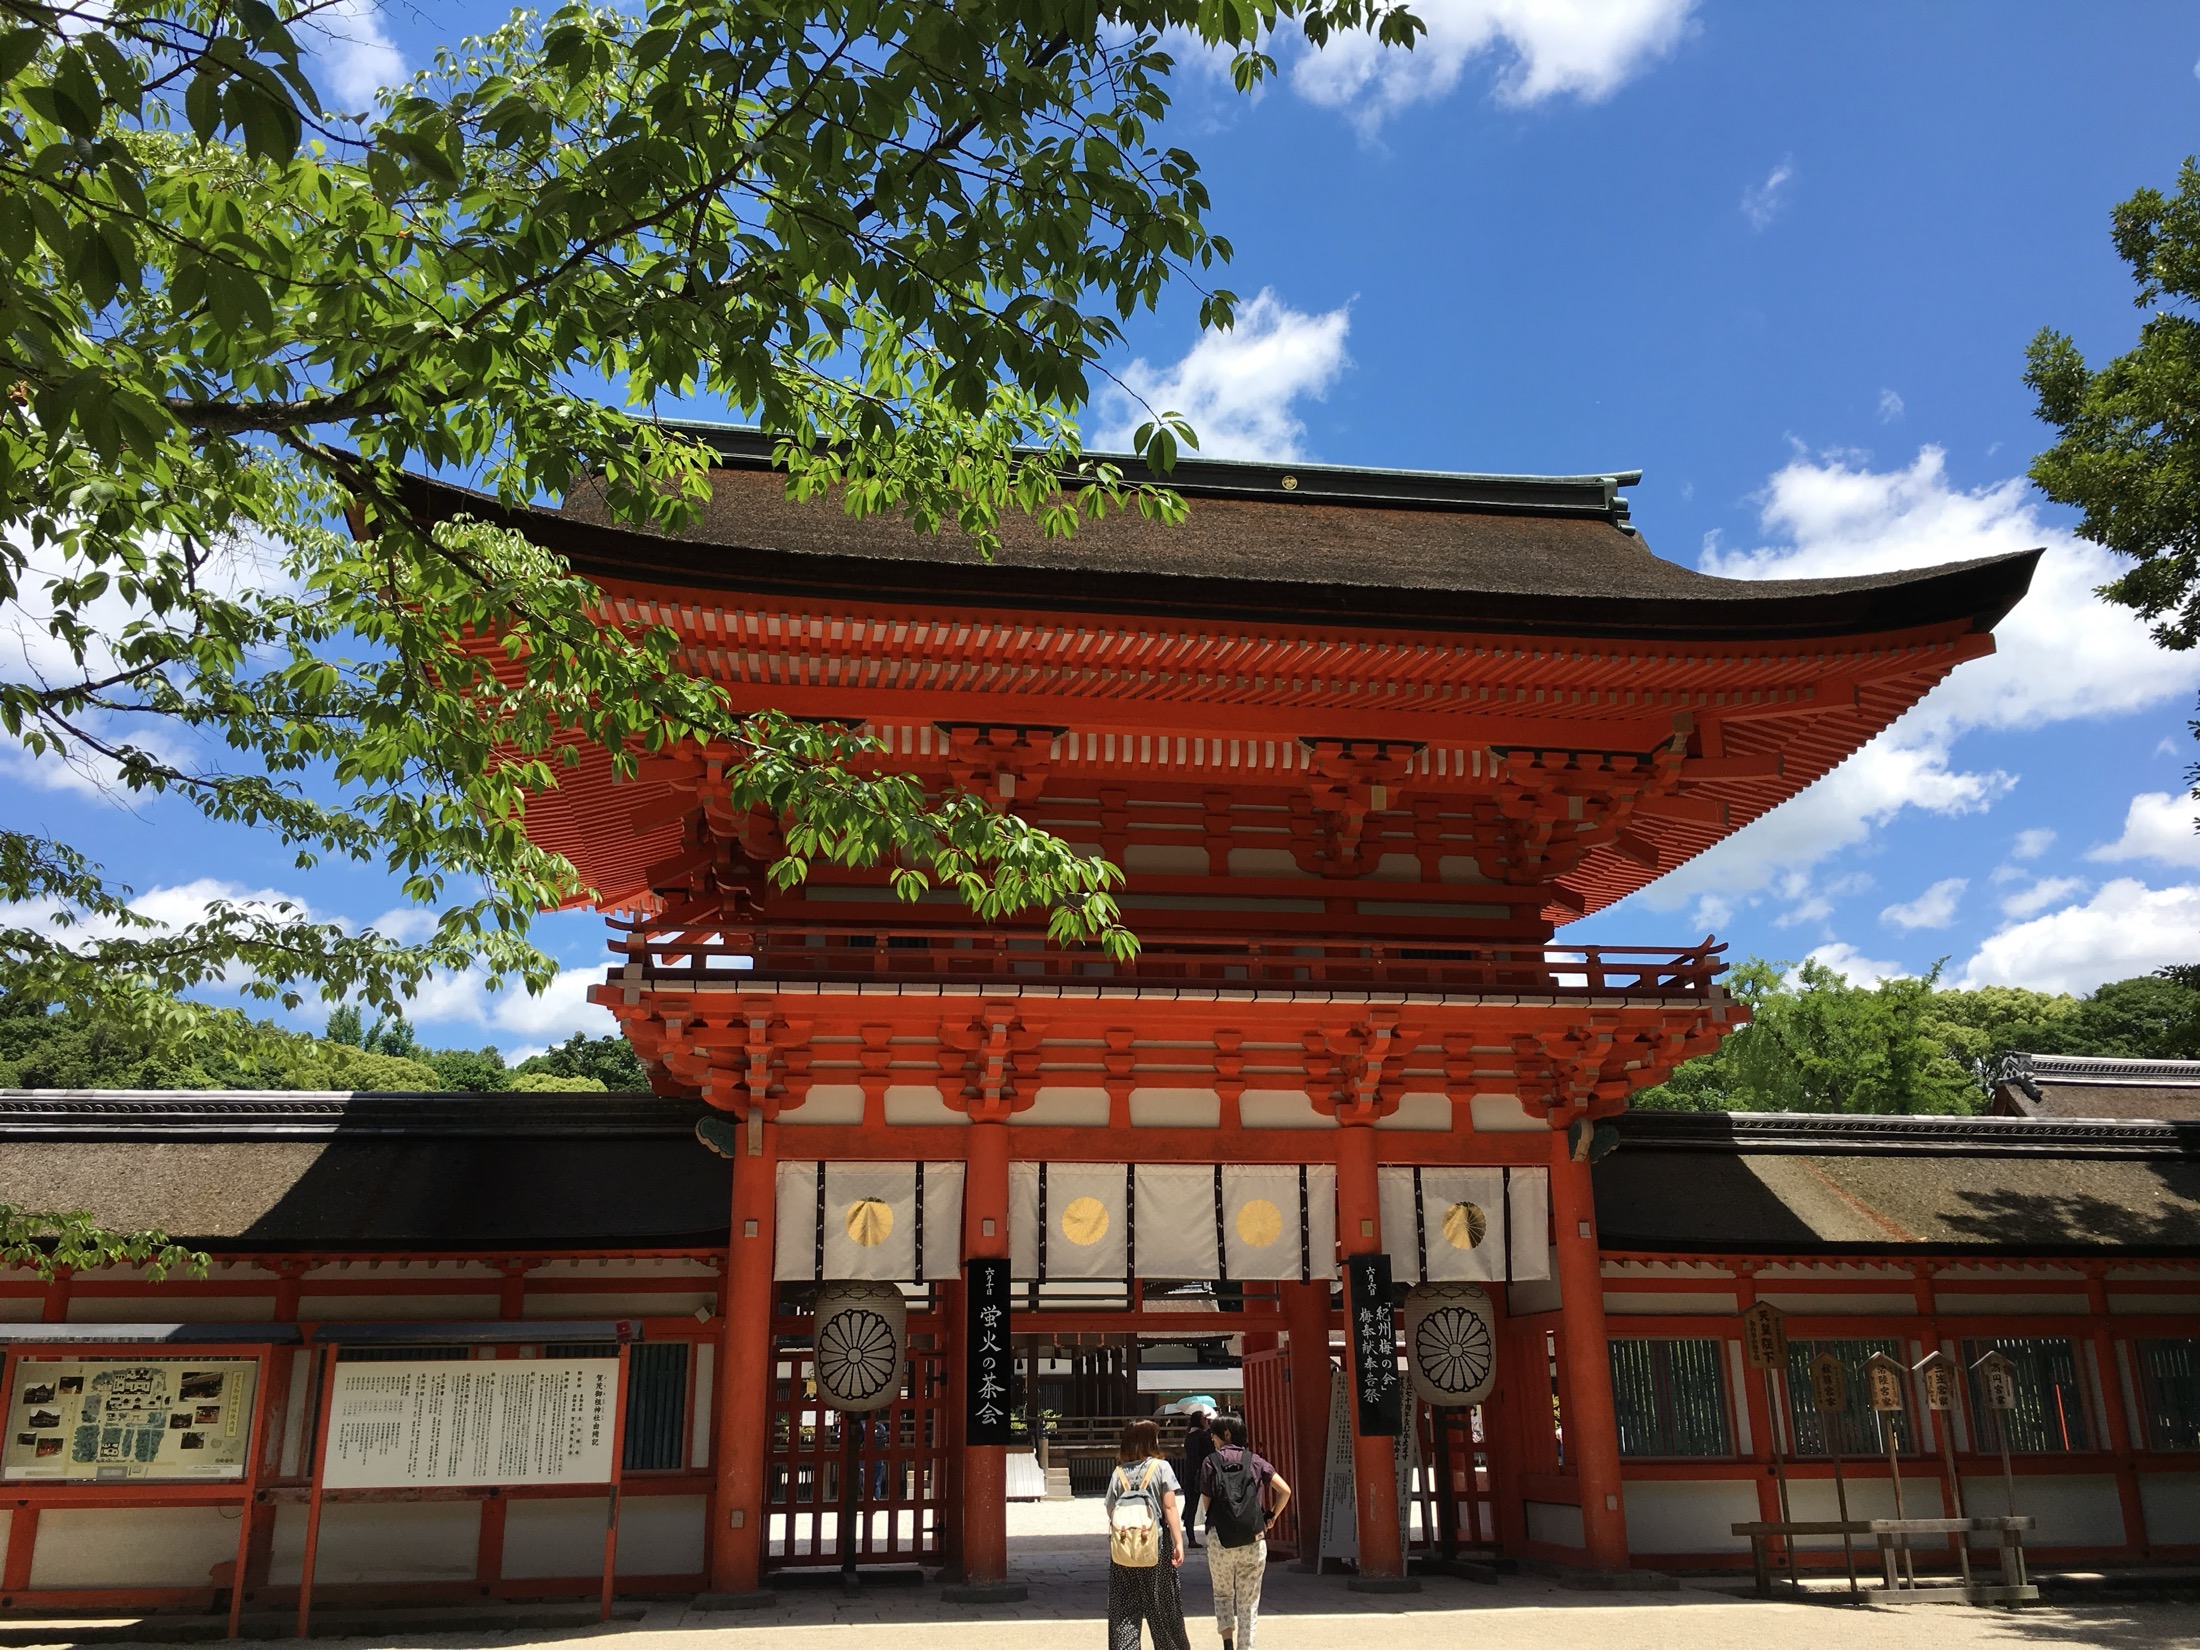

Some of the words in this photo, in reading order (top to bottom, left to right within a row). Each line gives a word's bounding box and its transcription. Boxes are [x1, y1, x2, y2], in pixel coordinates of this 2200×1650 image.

[984, 1266, 995, 1296] 六月十日
[1365, 1265, 1377, 1296] 六月六日
[1358, 1306, 1382, 1404] 梅奉献奉告祭
[1758, 1310, 1774, 1364] 天皇陛下
[974, 1304, 1007, 1426] 蛍火の茶会
[1934, 1363, 1949, 1406] 三笠宮家
[1990, 1362, 2006, 1405] 高円宮家
